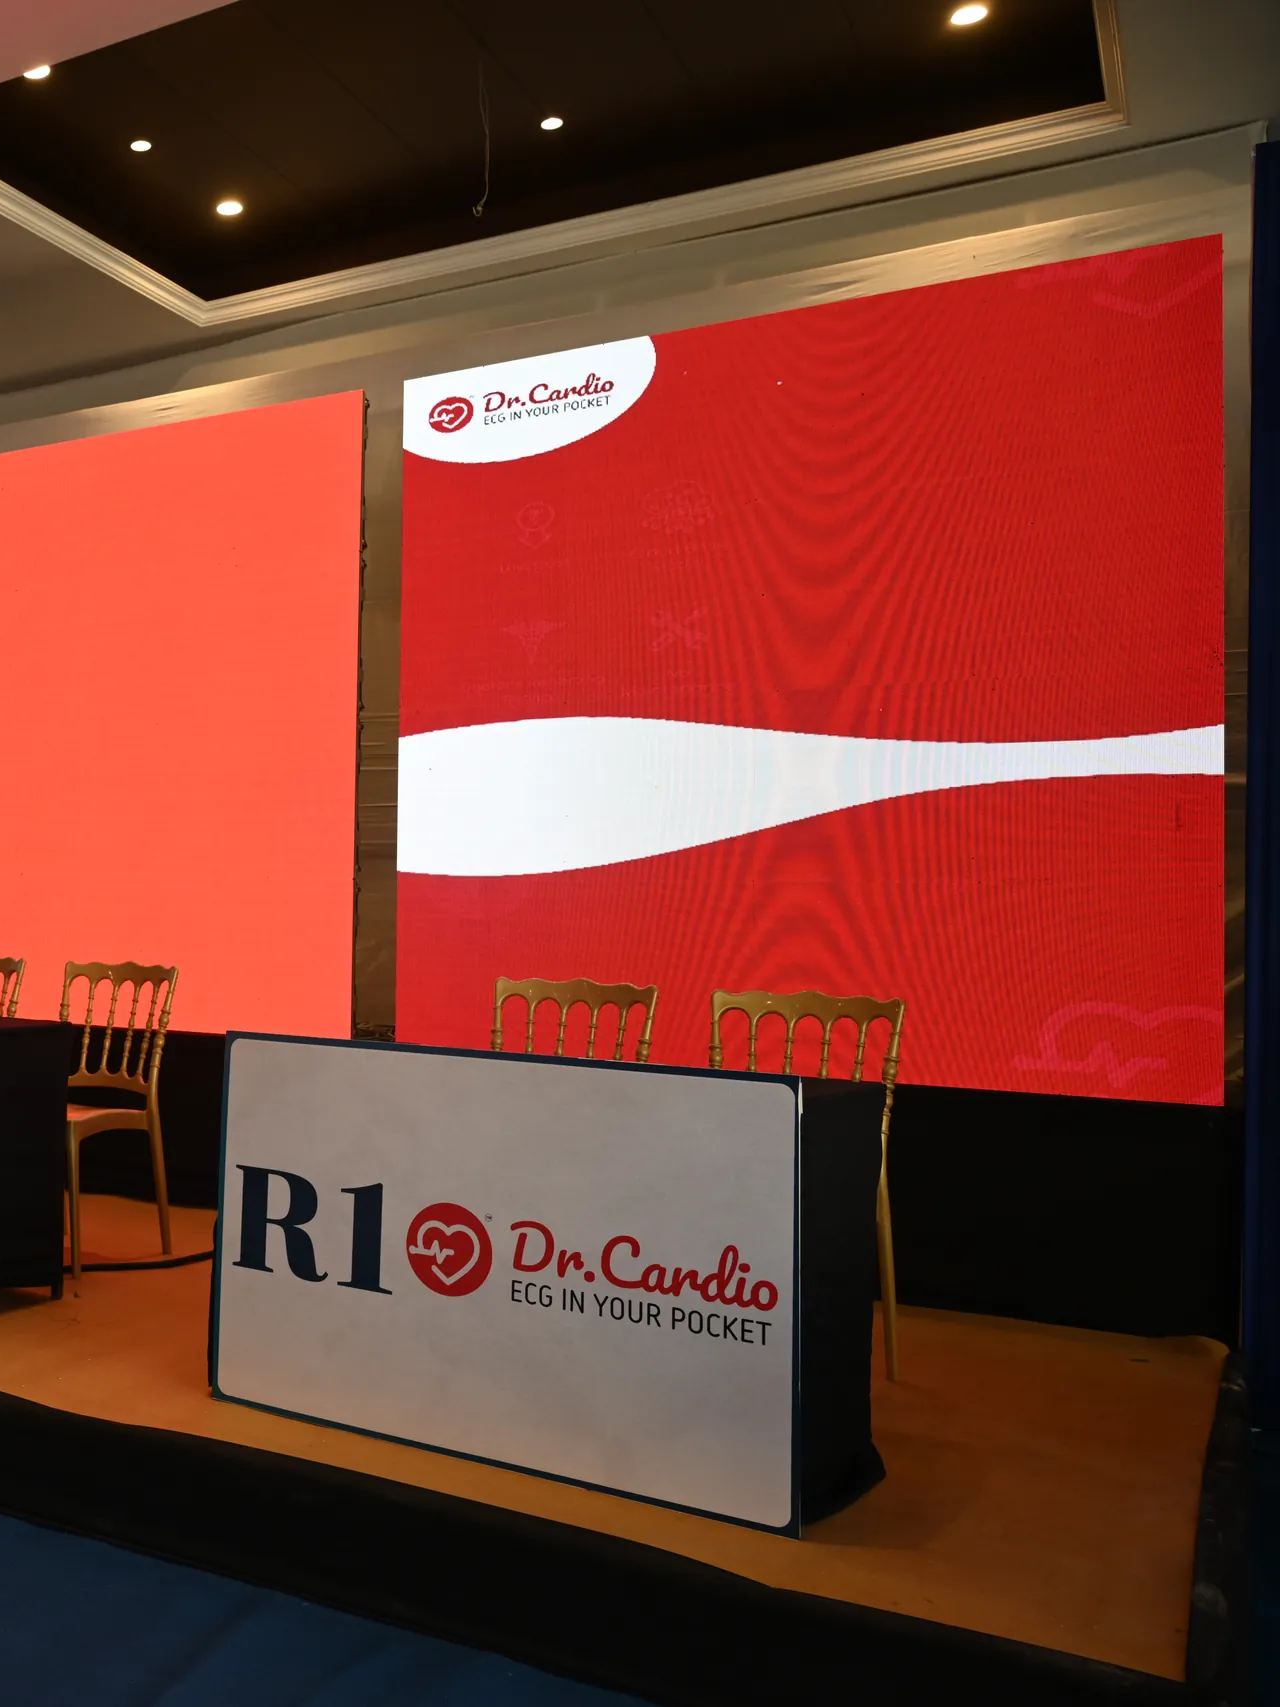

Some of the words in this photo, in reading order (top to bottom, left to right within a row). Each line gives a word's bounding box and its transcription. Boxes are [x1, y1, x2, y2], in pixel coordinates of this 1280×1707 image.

[483, 372, 615, 413] Dr.Cardio
[484, 414, 506, 426] ECG
[509, 410, 522, 421] IN
[525, 404, 559, 418] YOUR
[564, 395, 612, 413] POCKET
[233, 1164, 393, 1296] R1
[510, 1220, 779, 1311] Dr.Cardio
[511, 1279, 553, 1308] ECG
[562, 1288, 585, 1314] IN
[593, 1293, 661, 1328] YOUR
[671, 1307, 772, 1346] POCKET
